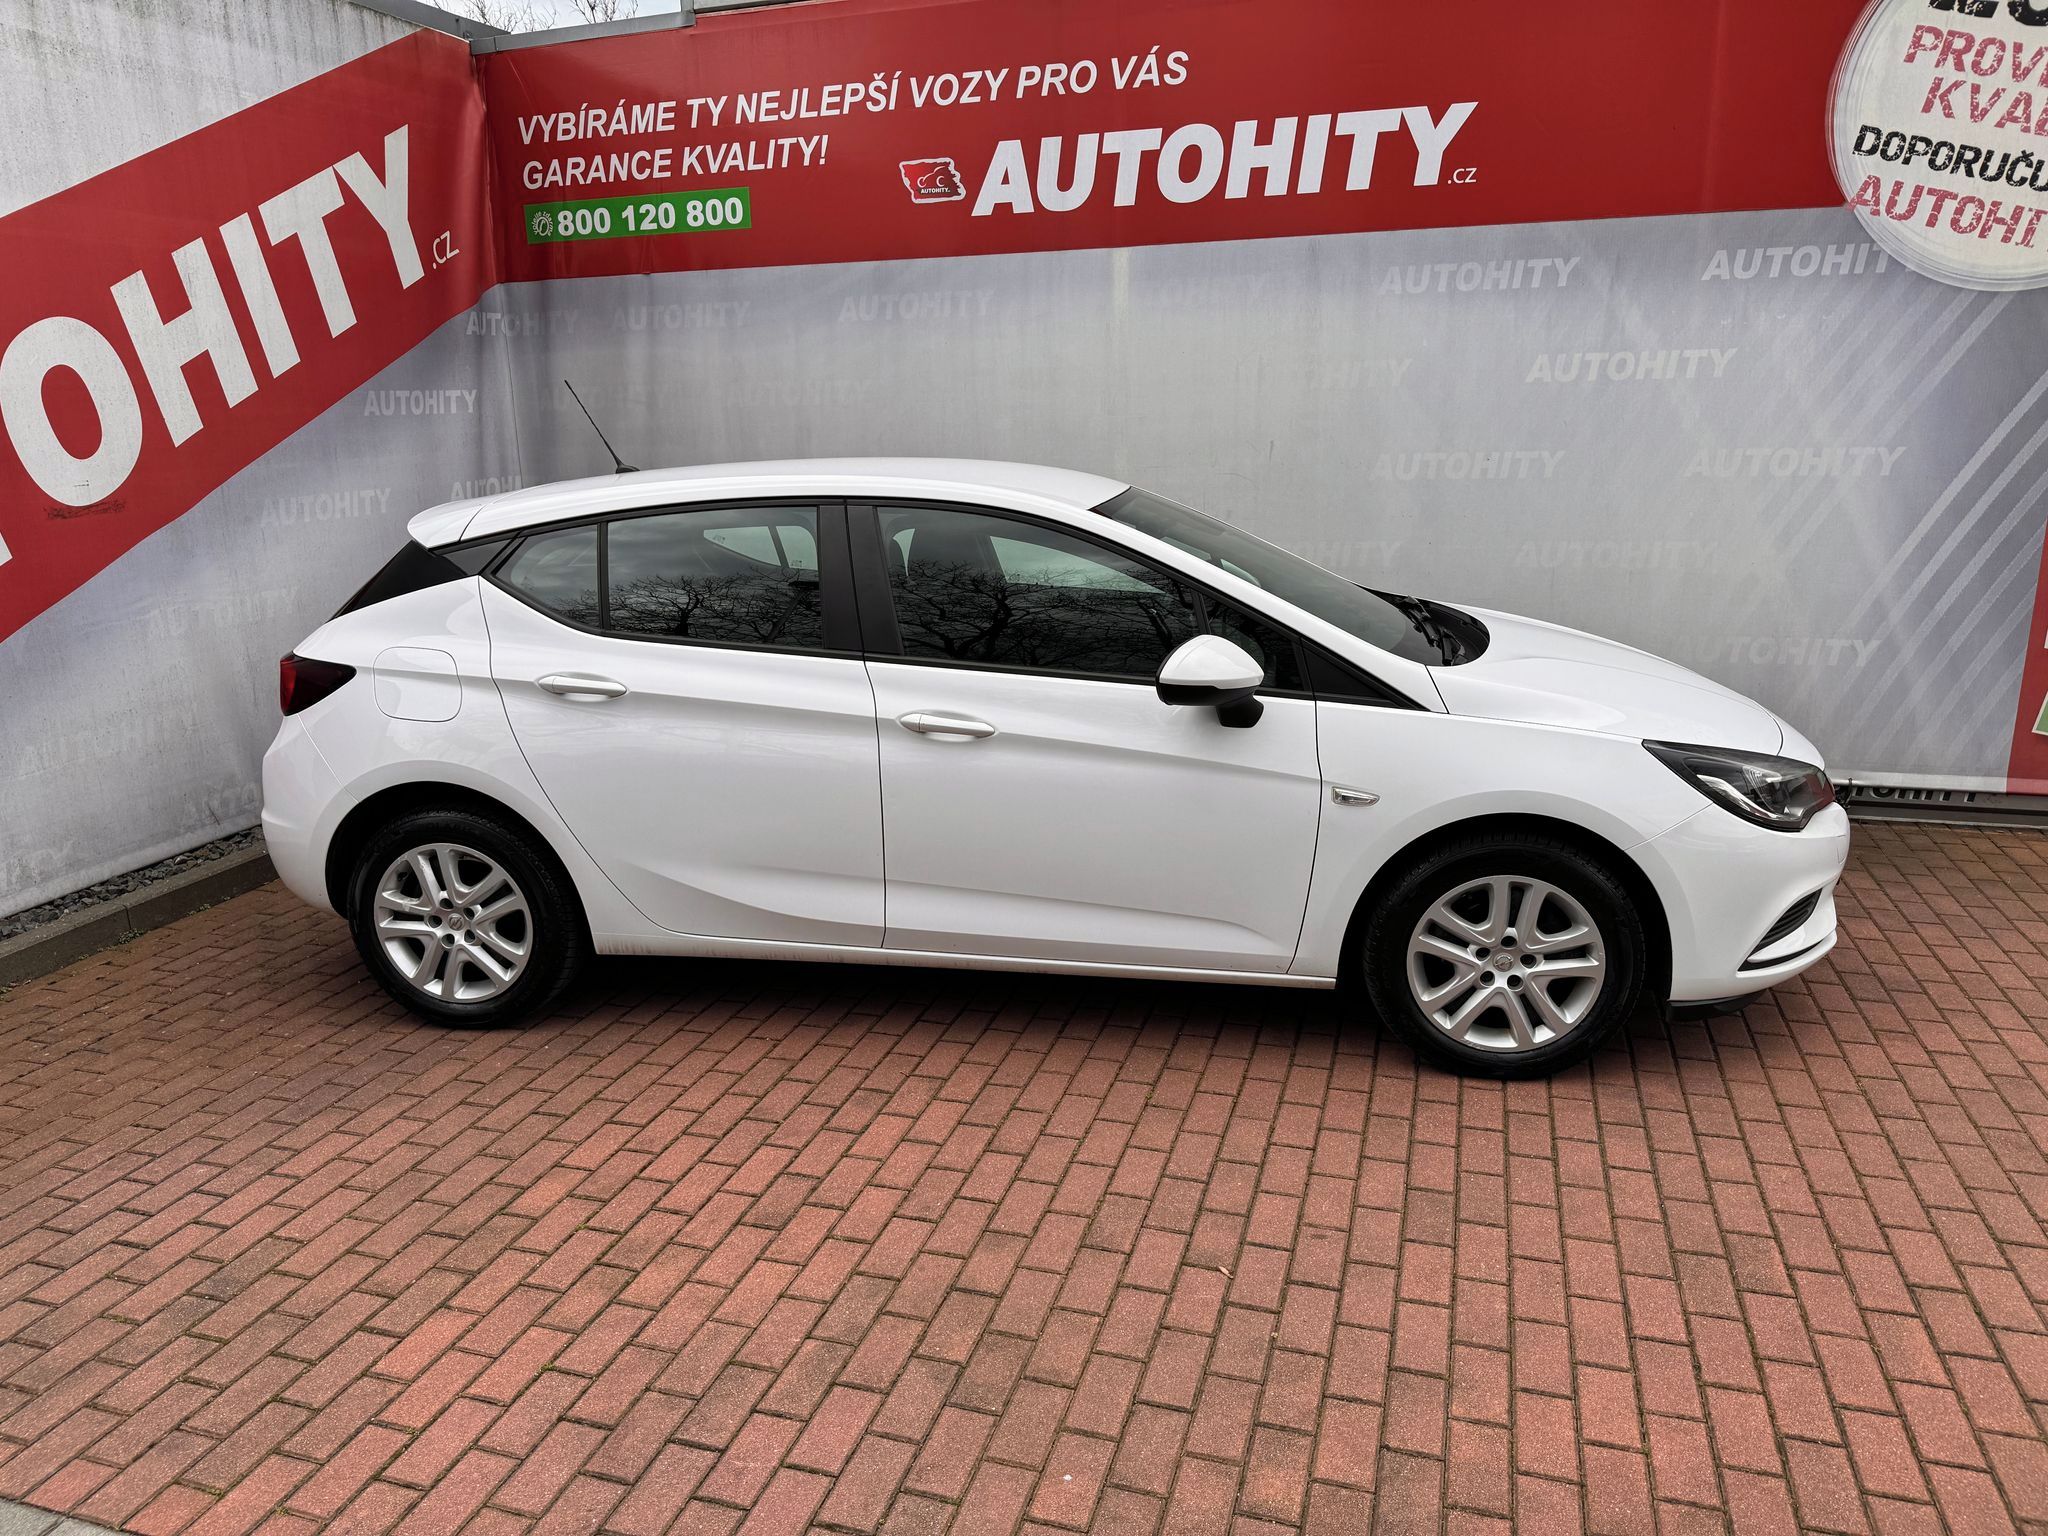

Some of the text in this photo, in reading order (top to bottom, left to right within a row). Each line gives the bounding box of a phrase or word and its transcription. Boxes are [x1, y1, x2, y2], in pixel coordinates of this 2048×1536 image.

[518, 45, 1189, 145] VYBÍRÁME TY NEJLEPŠÍ VOZY PRO VÁS
[522, 134, 829, 190] GARANCE KVALITY!
[557, 197, 744, 237] 800 120 800
[1850, 174, 2048, 249] AUTOHI
[1379, 256, 1580, 295] AUTOHITY
[1701, 243, 1918, 281] AUTOHIT
[838, 290, 996, 323] AUTOHITY
[0, 124, 425, 567] OHITY
[1525, 347, 1738, 383] AUTOHITY
[364, 388, 478, 417] AUTOHITY
[1370, 449, 1566, 482] AUTOHITY
[1685, 446, 1907, 478] AUTOHITY
[260, 488, 391, 528] AUTOHITY
